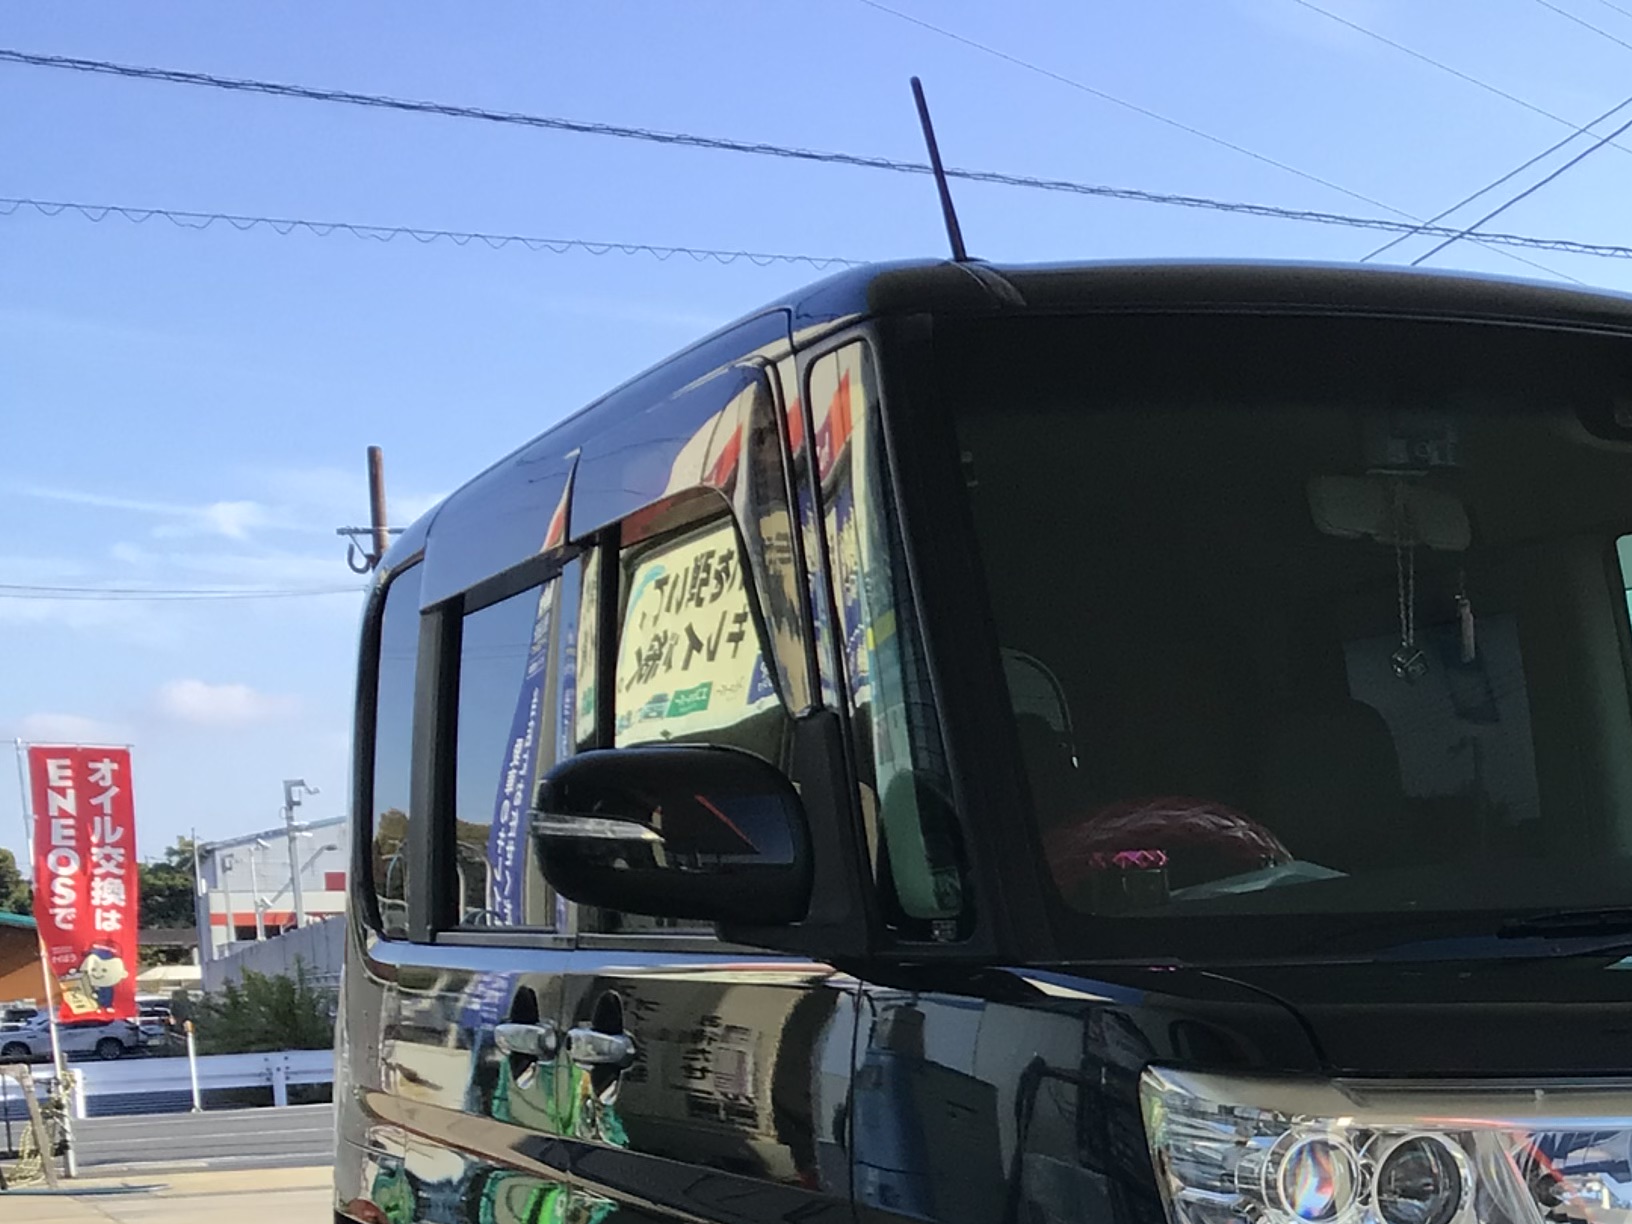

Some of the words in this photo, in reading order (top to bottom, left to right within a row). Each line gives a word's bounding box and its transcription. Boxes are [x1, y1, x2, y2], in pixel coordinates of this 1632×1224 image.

[46, 758, 81, 930] ENEOSで
[88, 758, 127, 932] オイル交換は
